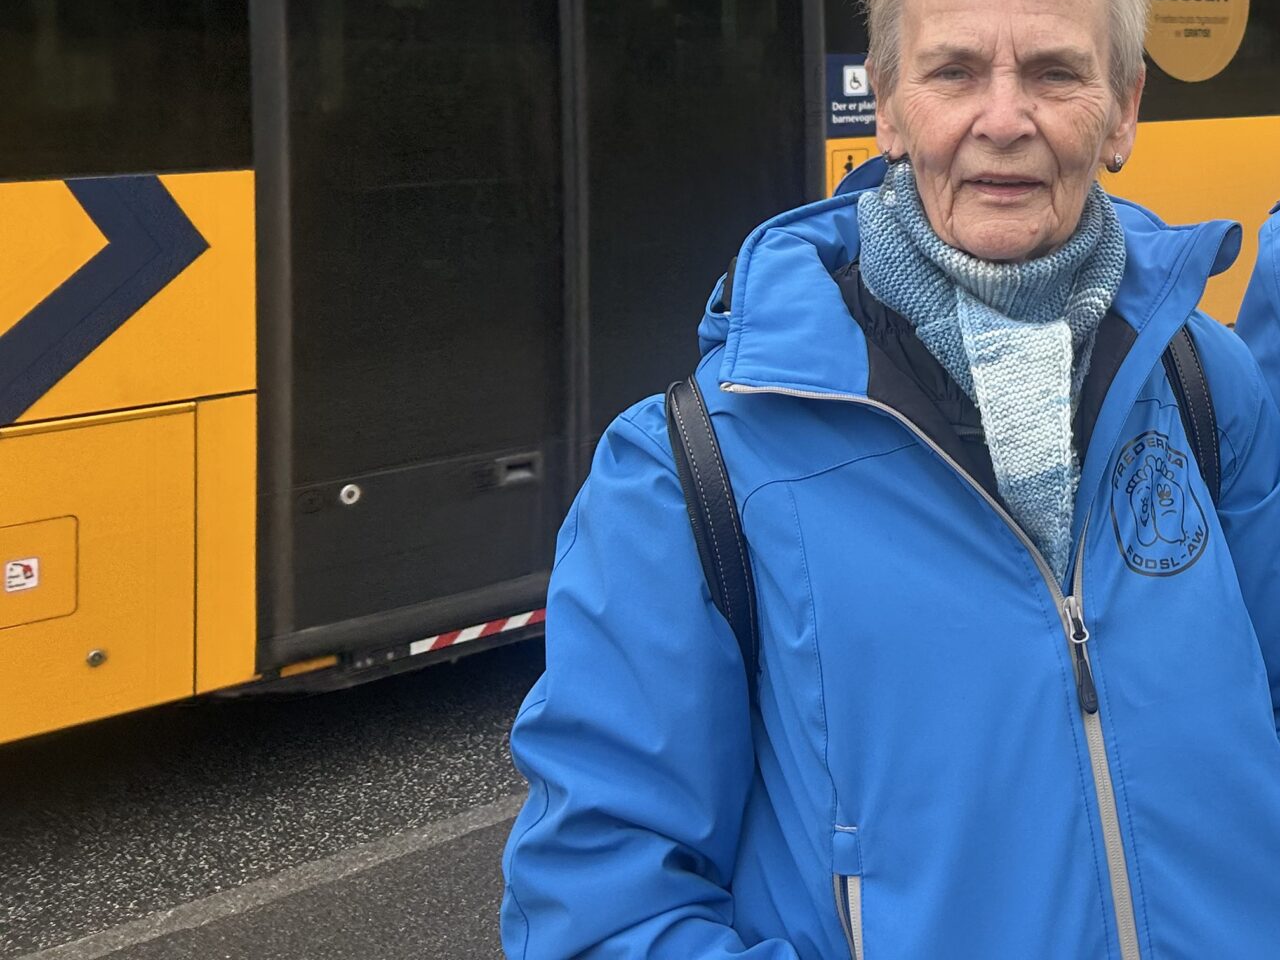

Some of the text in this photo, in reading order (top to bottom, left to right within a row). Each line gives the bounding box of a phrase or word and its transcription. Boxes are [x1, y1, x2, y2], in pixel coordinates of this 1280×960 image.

[832, 101, 876, 112] Der er plad
[1114, 437, 1184, 490] FREDERIIA
